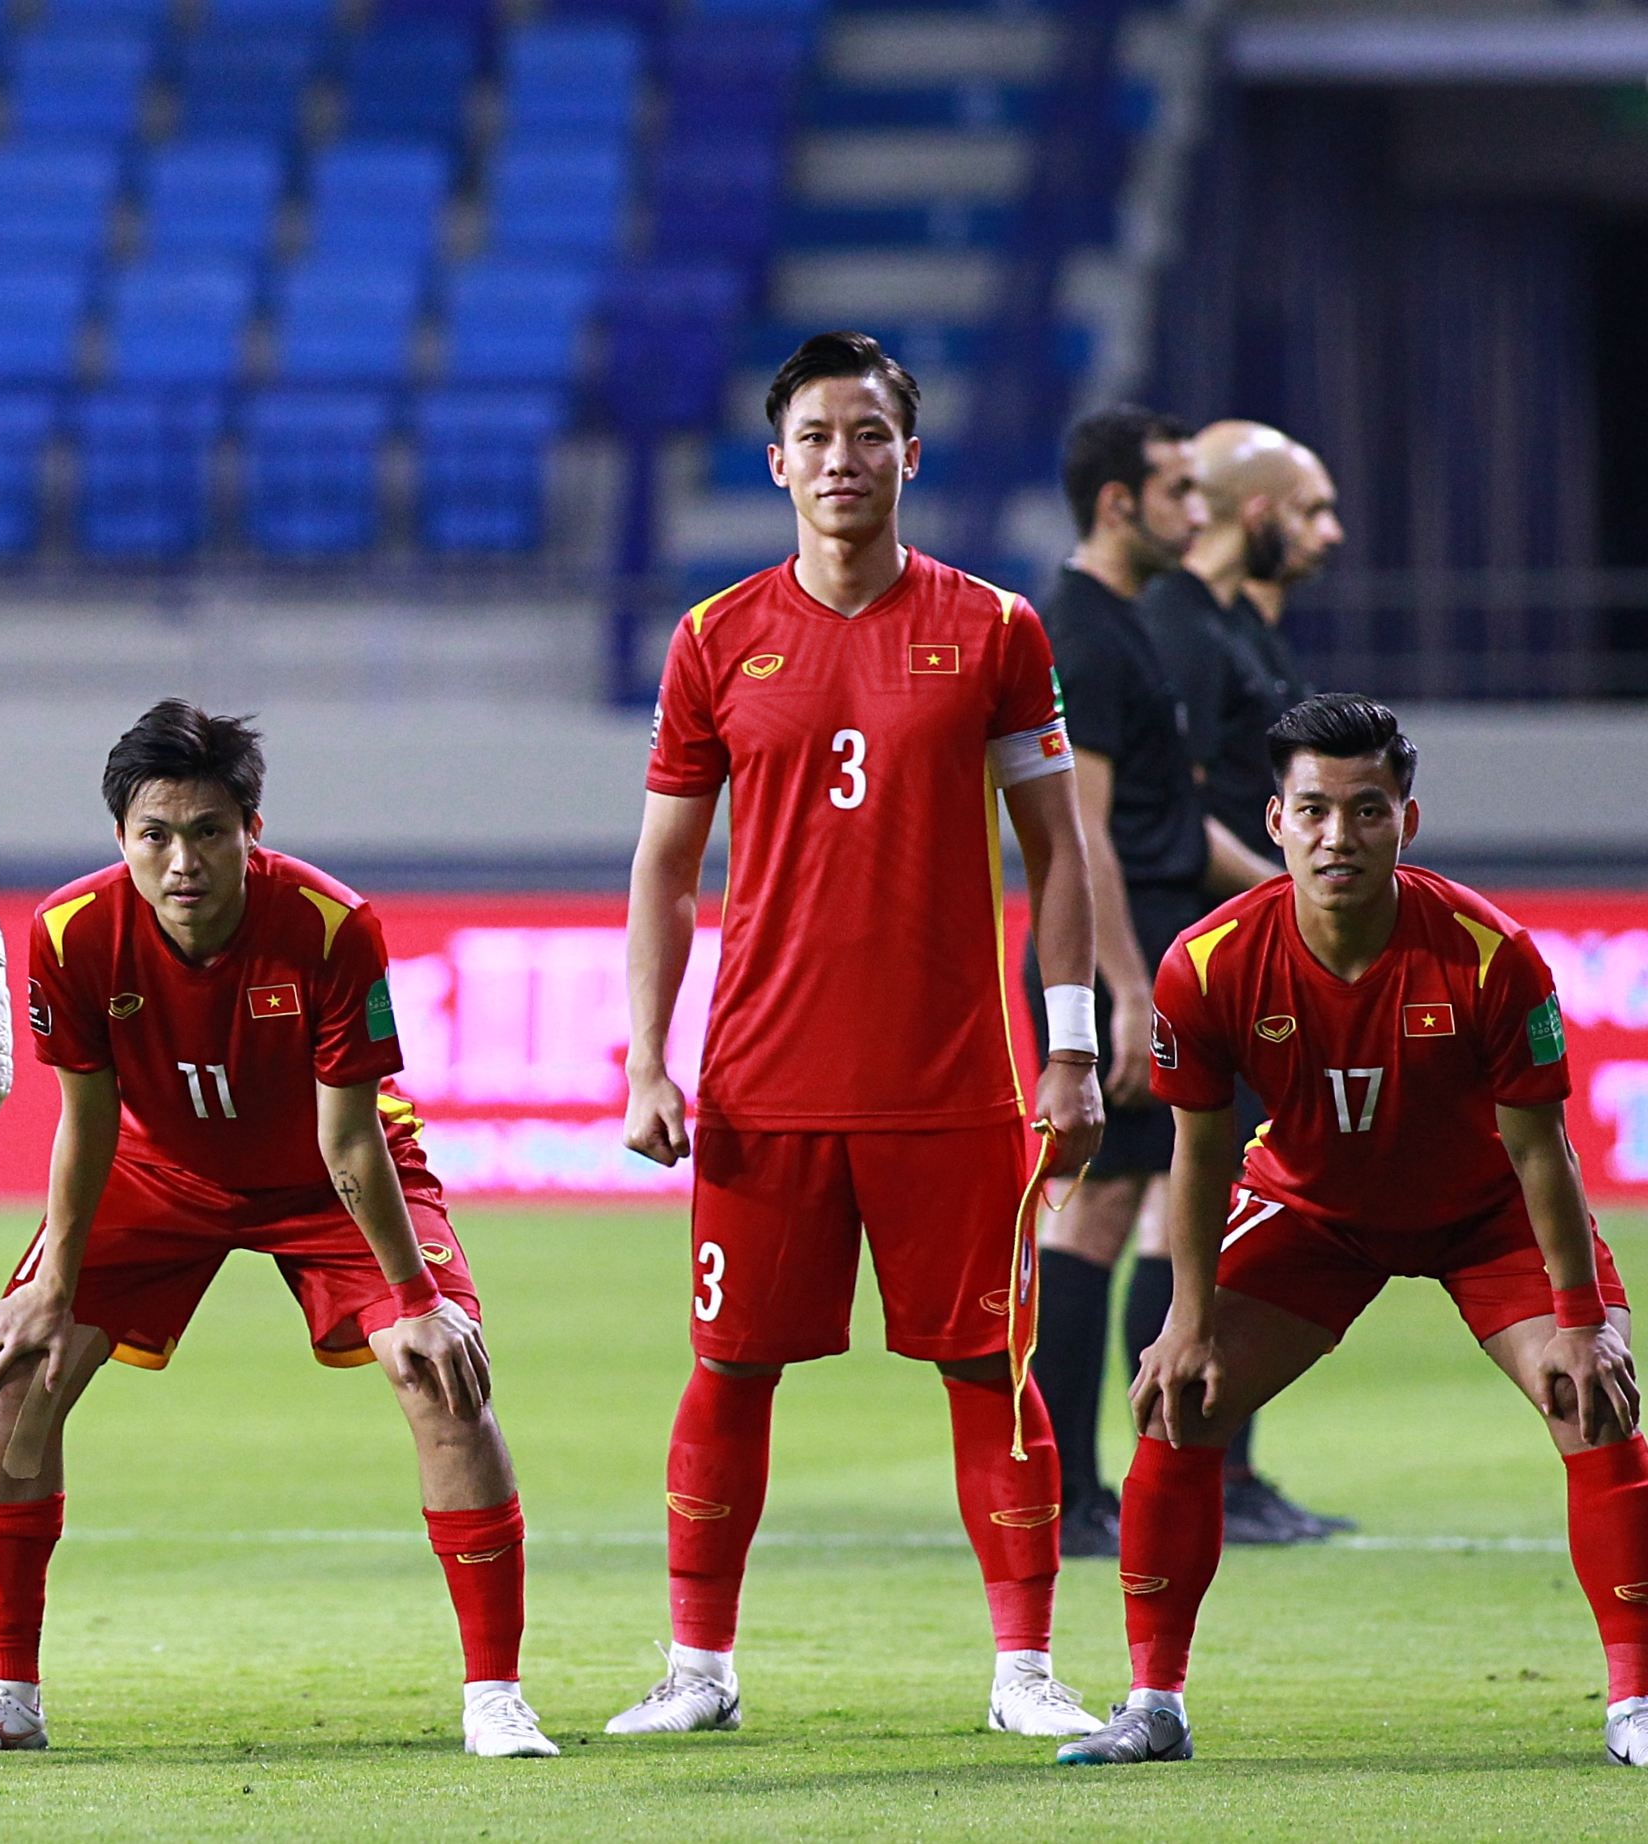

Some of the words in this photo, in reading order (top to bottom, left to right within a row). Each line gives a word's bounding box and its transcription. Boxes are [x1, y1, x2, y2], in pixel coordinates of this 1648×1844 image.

[829, 728, 867, 810] 3
[177, 1061, 237, 1119] 11
[1323, 1066, 1384, 1133] 17
[1220, 1187, 1285, 1254] 17
[694, 1241, 725, 1322] 3
